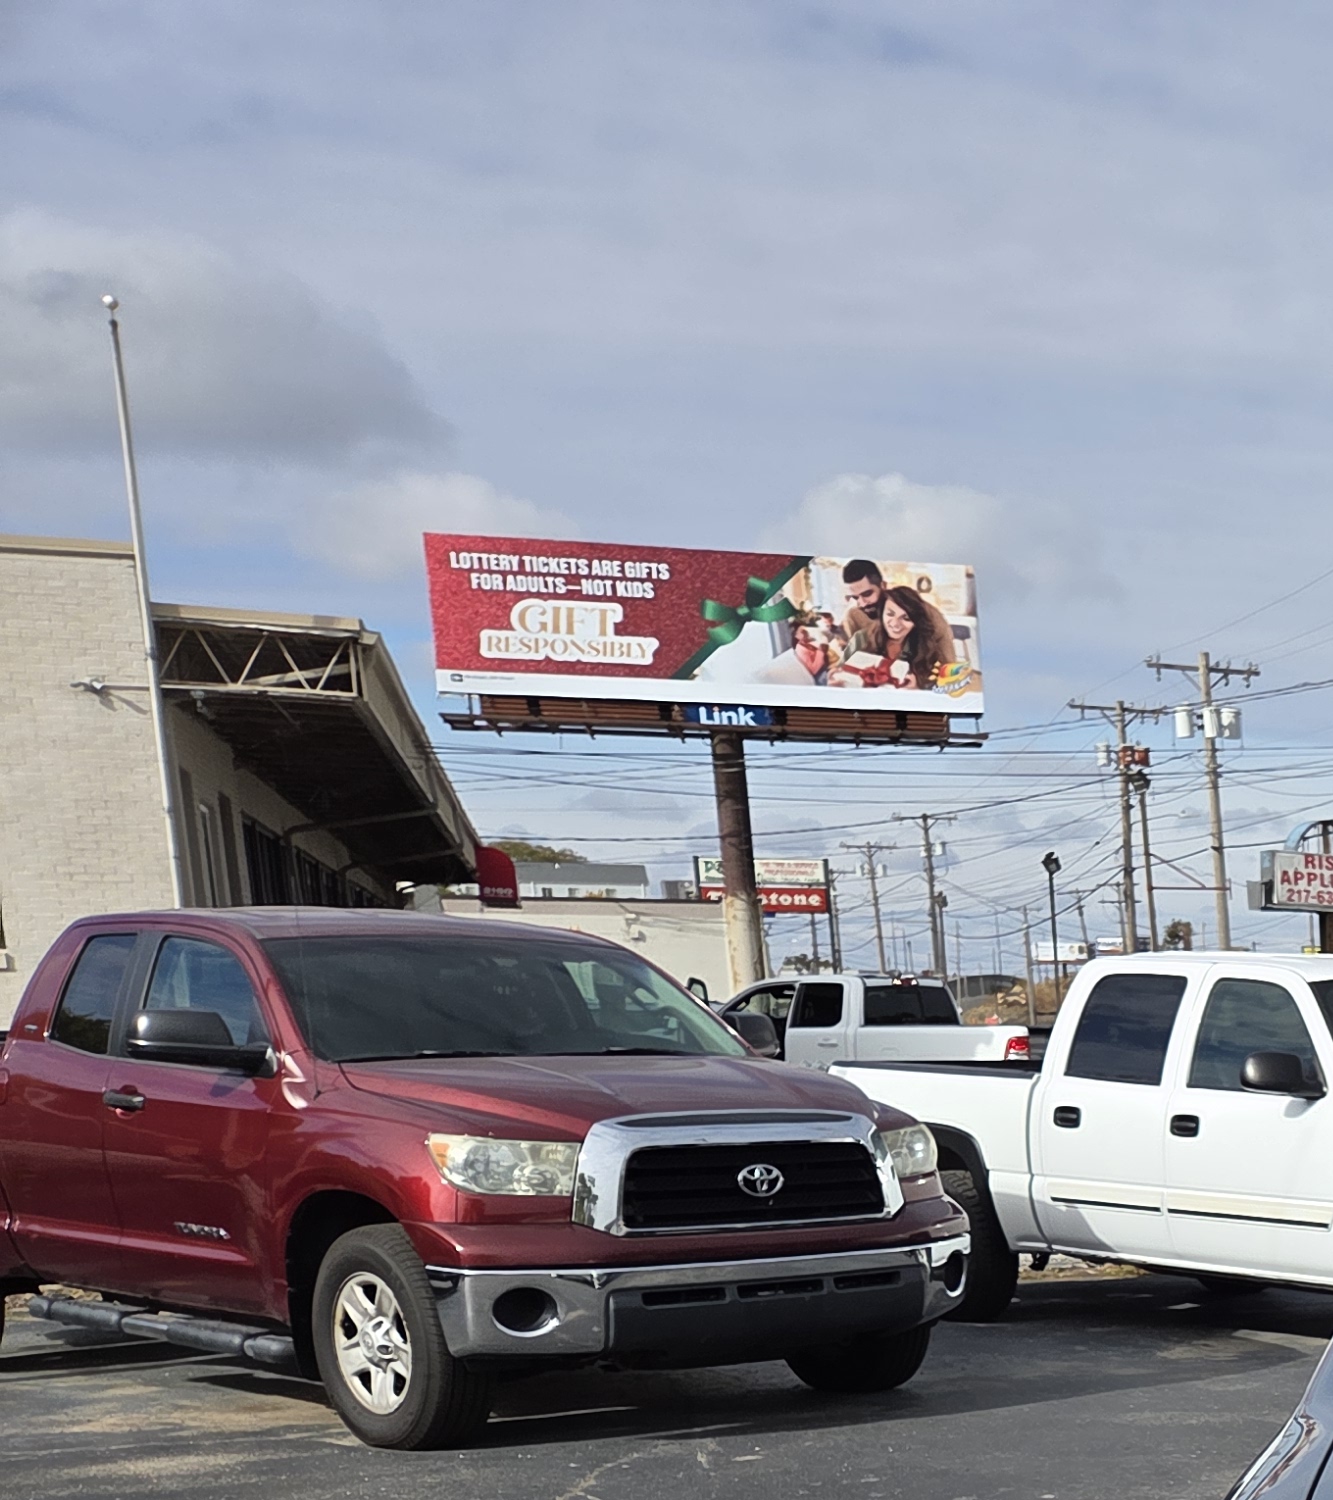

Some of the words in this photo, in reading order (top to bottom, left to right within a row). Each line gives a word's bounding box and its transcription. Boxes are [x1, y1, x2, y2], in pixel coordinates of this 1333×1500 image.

[449, 551, 520, 572] LOTTERY
[522, 554, 589, 576] TICKETS
[591, 559, 623, 577] ARE
[624, 561, 670, 580] GIFTS
[470, 573, 504, 591] FOR
[616, 580, 655, 599] KIDS
[517, 604, 617, 637] GIFT
[486, 634, 653, 660] RESPONSIBLY
[699, 706, 757, 726] Link
